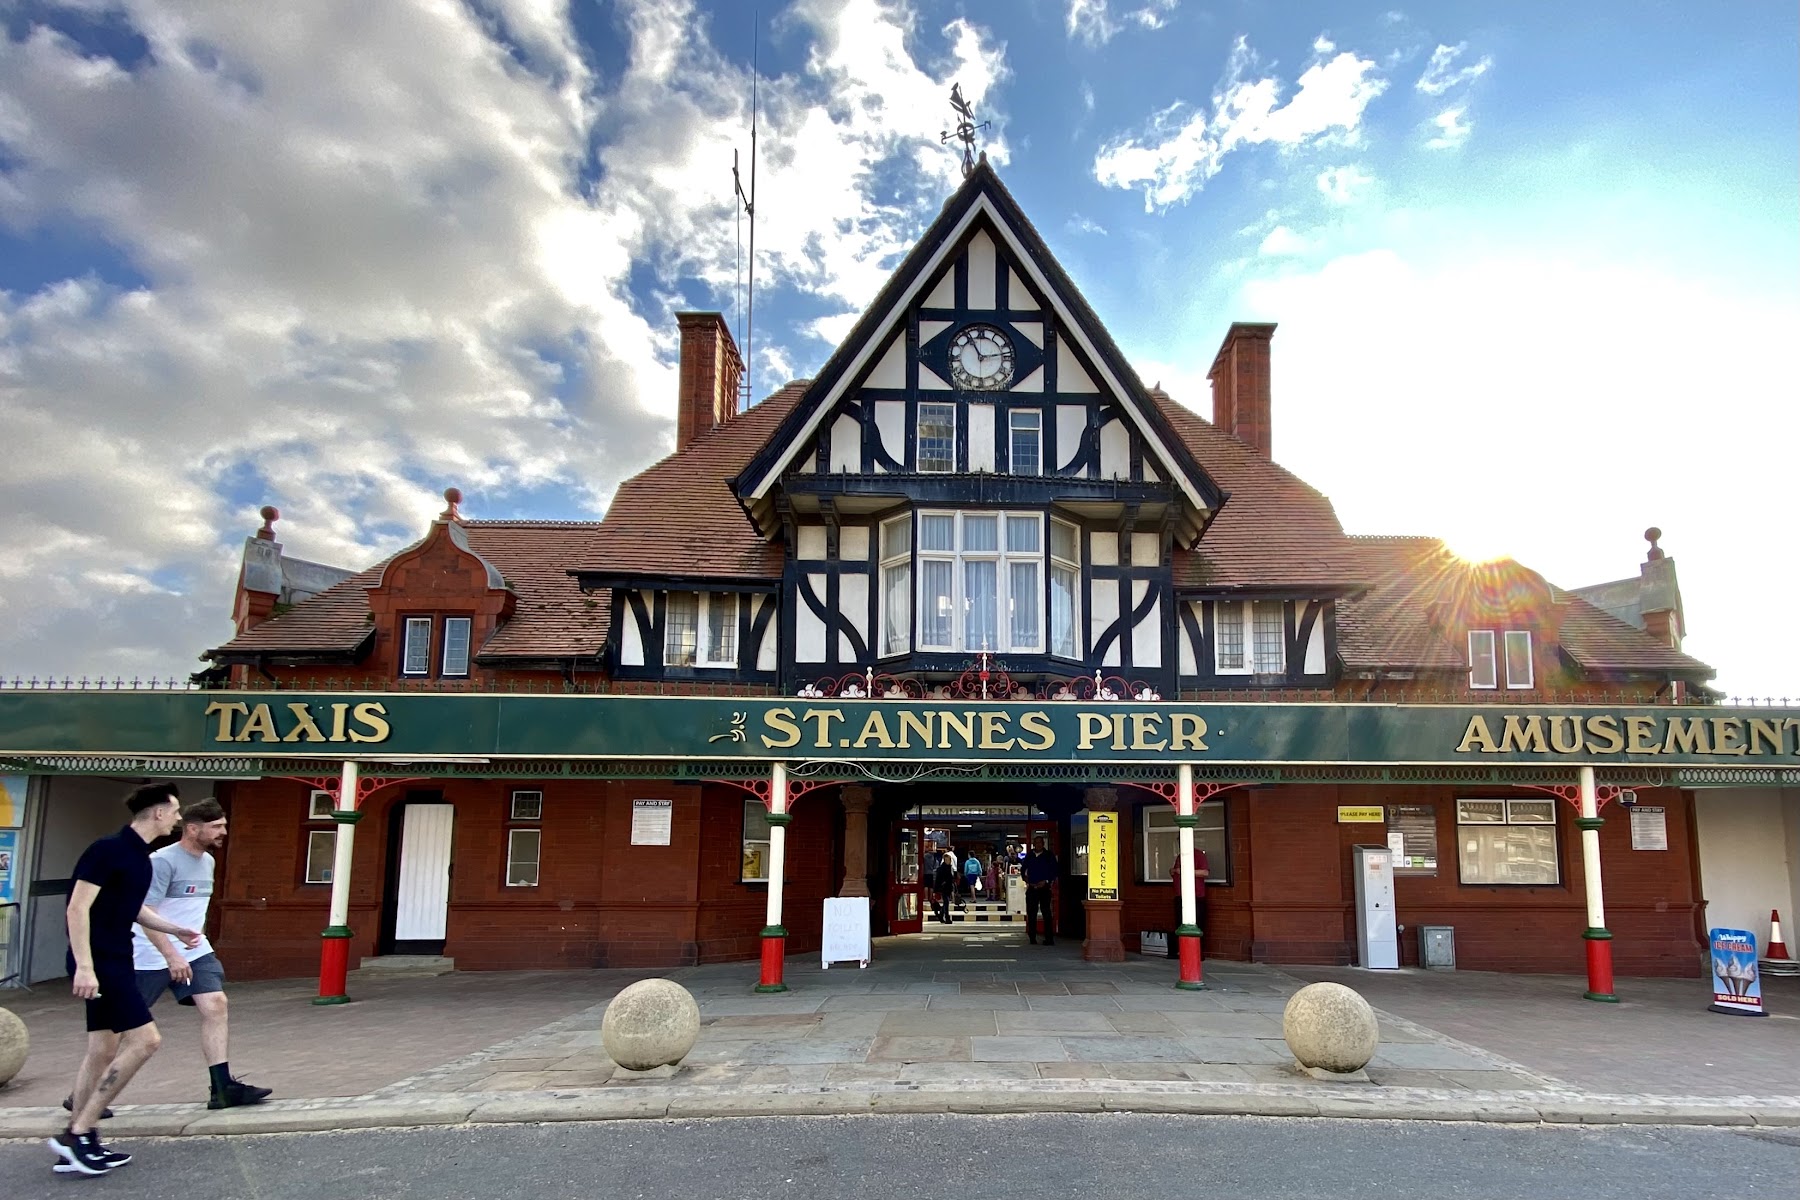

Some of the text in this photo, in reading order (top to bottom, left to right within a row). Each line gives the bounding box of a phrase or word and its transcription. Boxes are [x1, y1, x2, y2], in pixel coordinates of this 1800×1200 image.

[205, 702, 390, 743] TAXIS
[763, 706, 1209, 754] ST.ANNES PIER
[834, 905, 852, 917] NO
[1718, 934, 1747, 943] Whippy
[1714, 941, 1753, 952] ICE CREAM
[1738, 996, 1758, 1004] HERE
